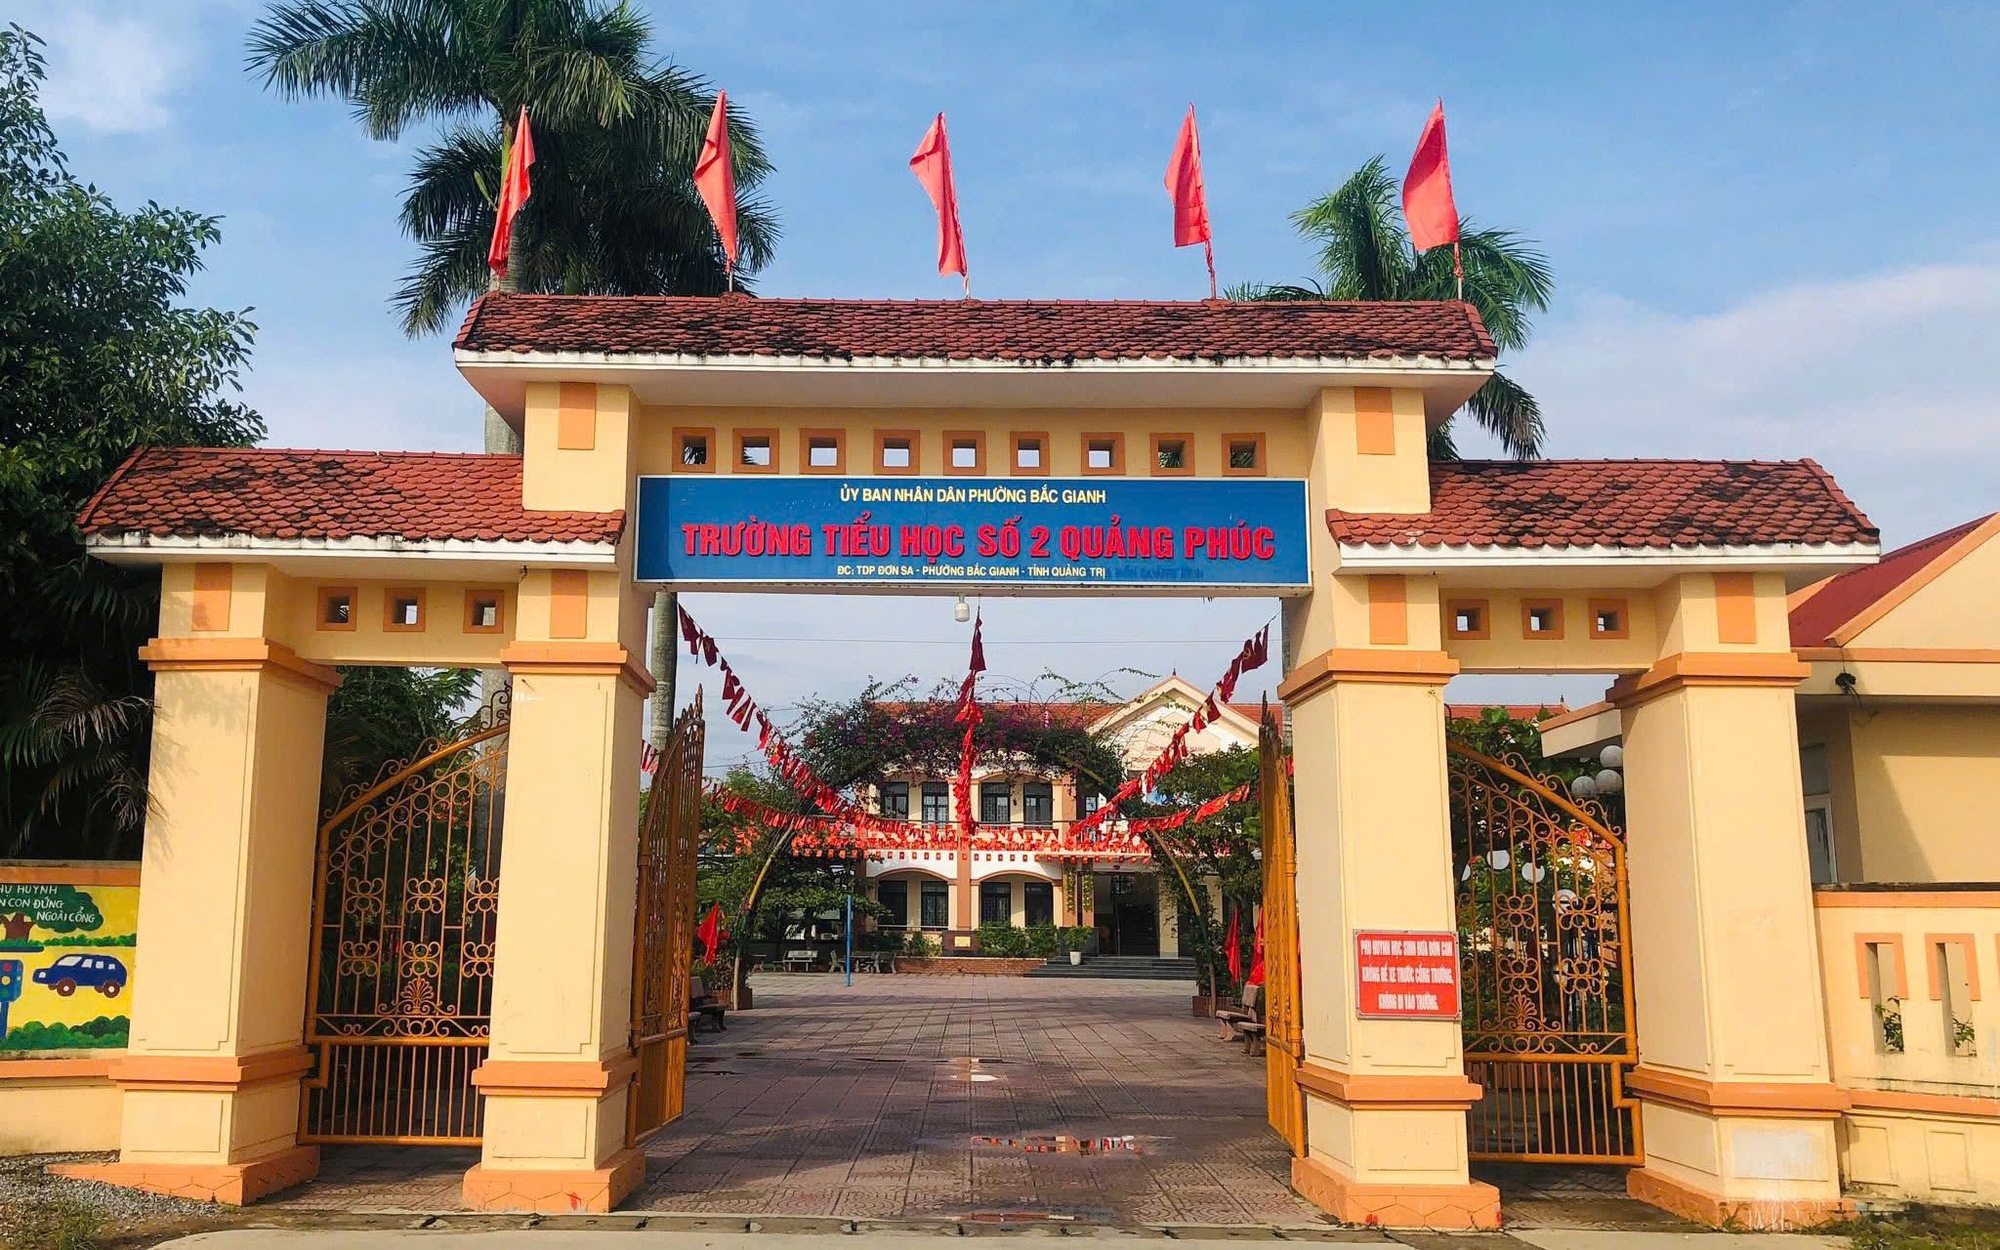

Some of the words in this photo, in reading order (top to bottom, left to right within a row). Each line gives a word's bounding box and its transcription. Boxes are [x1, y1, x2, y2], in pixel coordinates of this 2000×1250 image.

[840, 483, 860, 502] ỦY
[862, 488, 892, 502] BAN
[894, 485, 934, 503] NHÂN
[936, 486, 966, 503] DÂN
[968, 486, 1027, 503] PHƯỜNG
[1029, 483, 1059, 504] BẮC
[1061, 489, 1106, 504] GIANH
[681, 515, 812, 558] TRƯỜNG
[822, 511, 891, 557] TIỂU
[900, 524, 965, 565] HỌC
[976, 514, 1022, 558] SỐ
[1029, 526, 1051, 558] 2
[1059, 514, 1174, 561] QUẢNG
[1184, 519, 1275, 561] PHÚC
[837, 565, 855, 576] ĐC:
[856, 565, 876, 576] TDP
[878, 564, 899, 576] ĐƠN
[900, 566, 914, 576] SA
[922, 564, 964, 577] PHƯỜNG
[966, 562, 987, 577] BẮC
[989, 566, 1020, 578] GIANH
[1051, 563, 1087, 578] QUẢNG
[1089, 567, 1106, 580] TRỊ
[8, 897, 31, 908] CON
